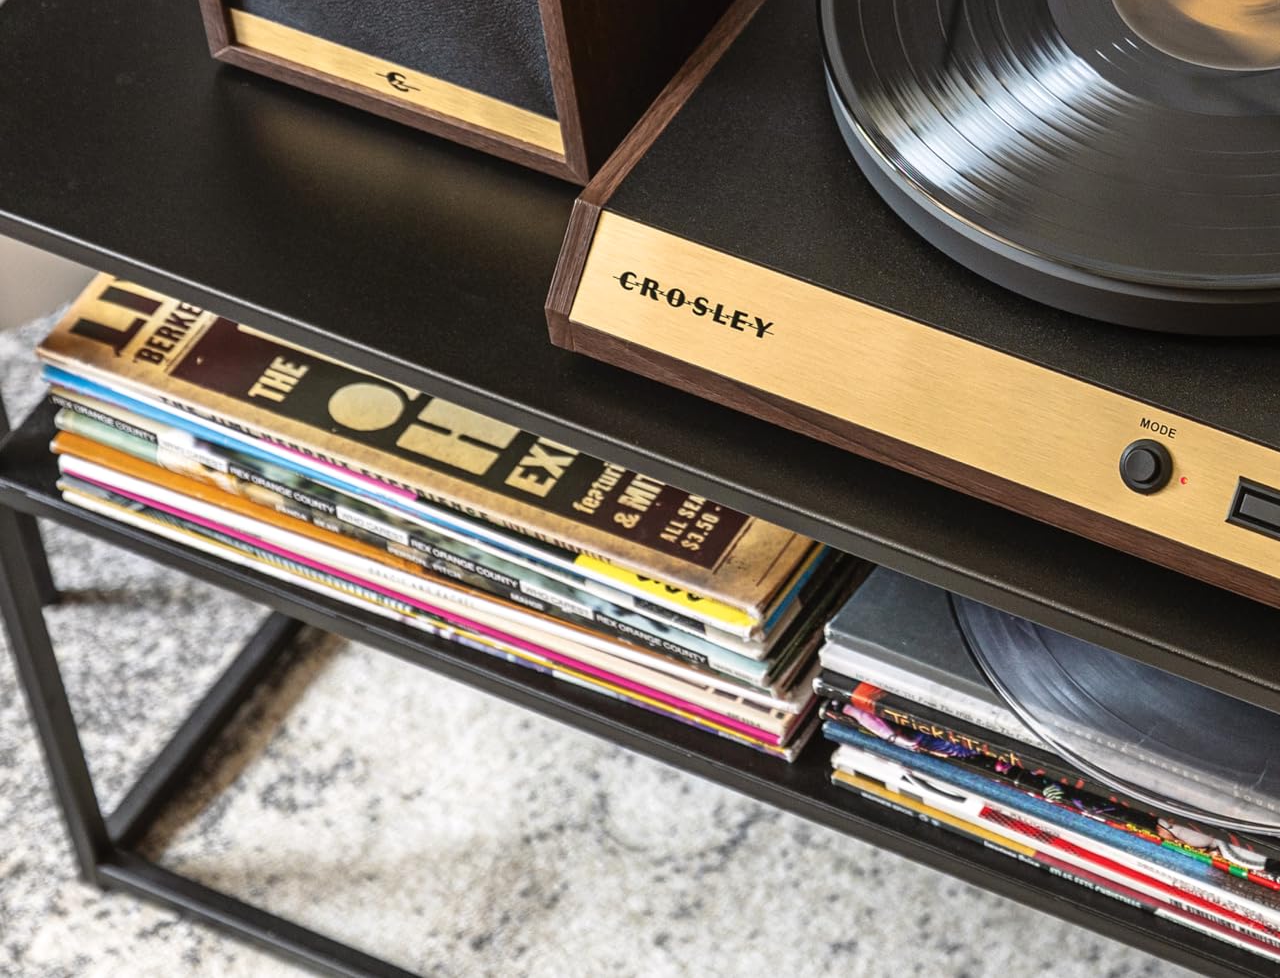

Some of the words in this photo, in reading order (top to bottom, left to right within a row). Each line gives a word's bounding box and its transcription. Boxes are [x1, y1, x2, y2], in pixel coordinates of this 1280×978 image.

[69, 286, 164, 357] LI
[614, 271, 774, 338] CROSLEY
[132, 302, 204, 365] BERKE
[248, 355, 310, 403] THE
[1140, 417, 1177, 440] MODE
[230, 465, 250, 479] REX
[252, 473, 292, 497] ORANGE
[294, 489, 335, 513] COUNTY
[504, 436, 580, 498] EX
[613, 511, 641, 530] &
[660, 520, 689, 543] ALL
[677, 494, 706, 519] SEA
[680, 513, 720, 551] $3.50
[411, 539, 431, 553] REX
[433, 547, 474, 572] ORANGE
[476, 564, 518, 588] COUNTY
[596, 614, 617, 628] REX
[618, 623, 662, 646] ORANGE
[663, 637, 706, 664] COUNTY
[883, 708, 944, 739] Trick
